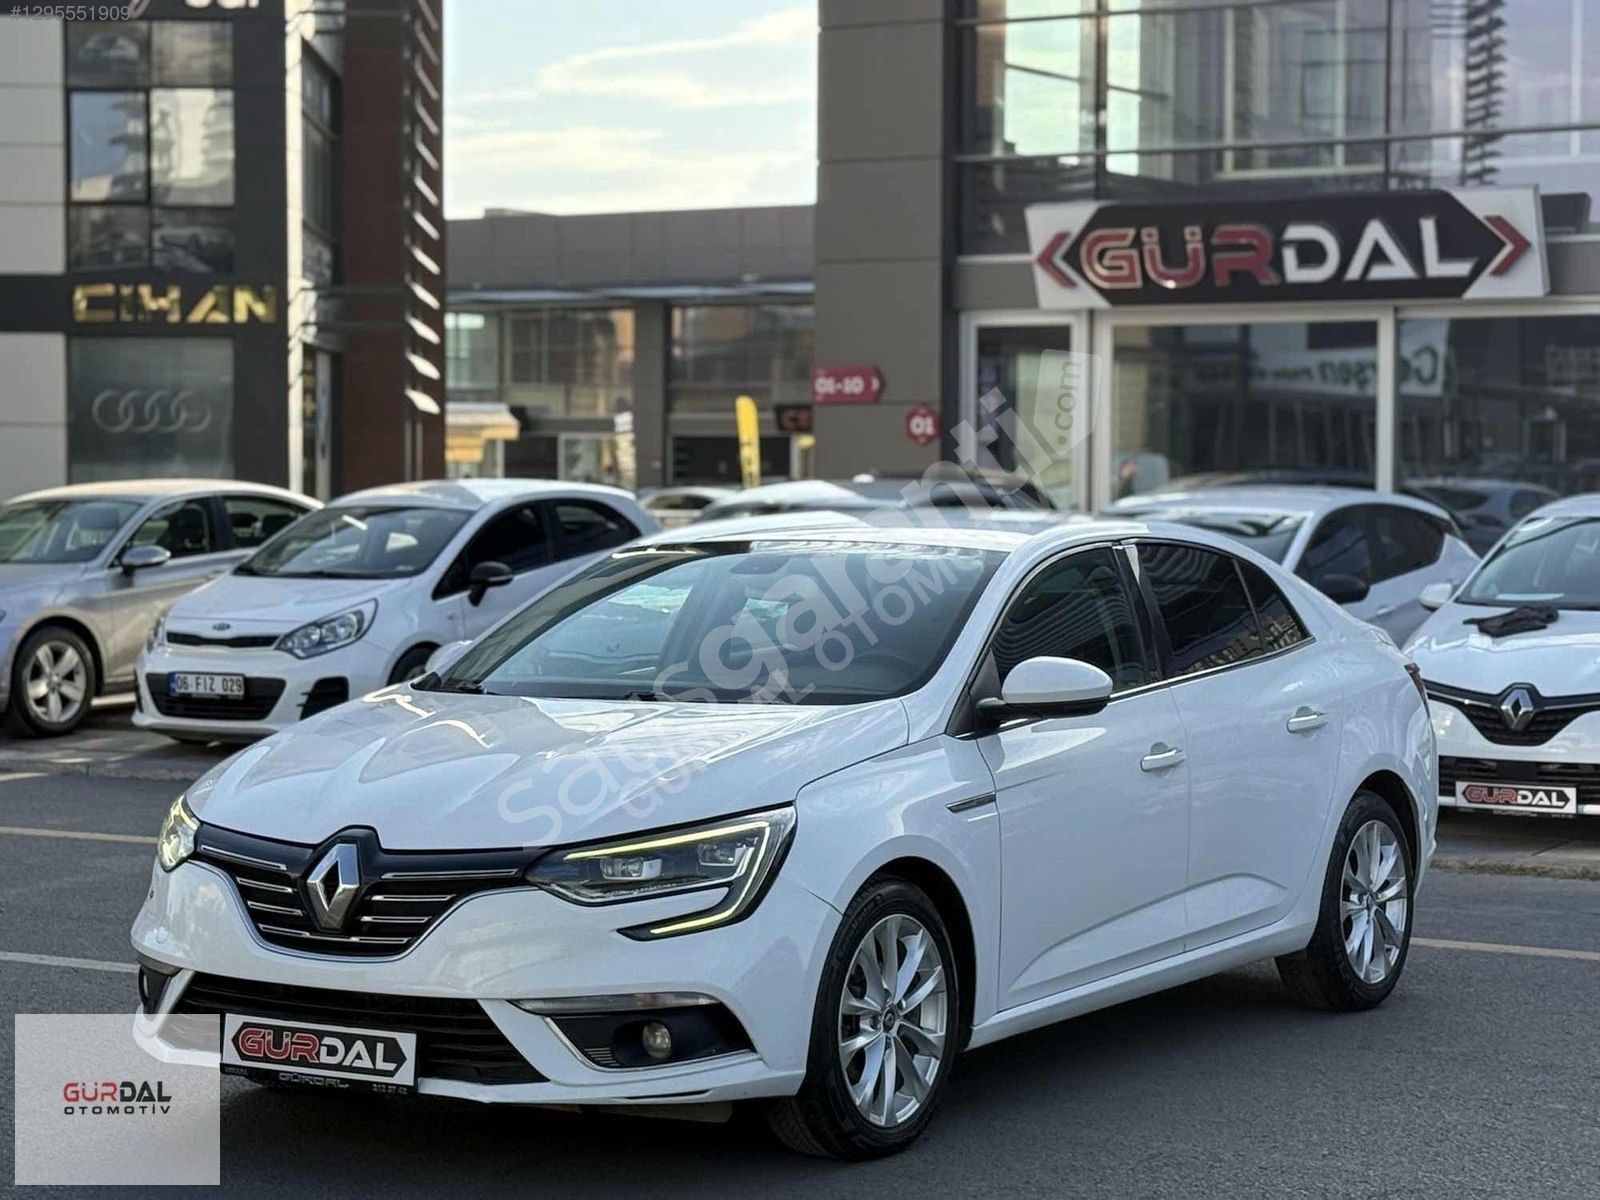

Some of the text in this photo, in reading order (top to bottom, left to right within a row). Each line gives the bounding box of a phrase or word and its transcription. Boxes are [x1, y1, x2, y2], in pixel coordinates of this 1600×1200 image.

[1080, 215, 1477, 288] GÜRDAL
[909, 416, 935, 435] 01
[176, 676, 242, 692] 06 FIZ 029
